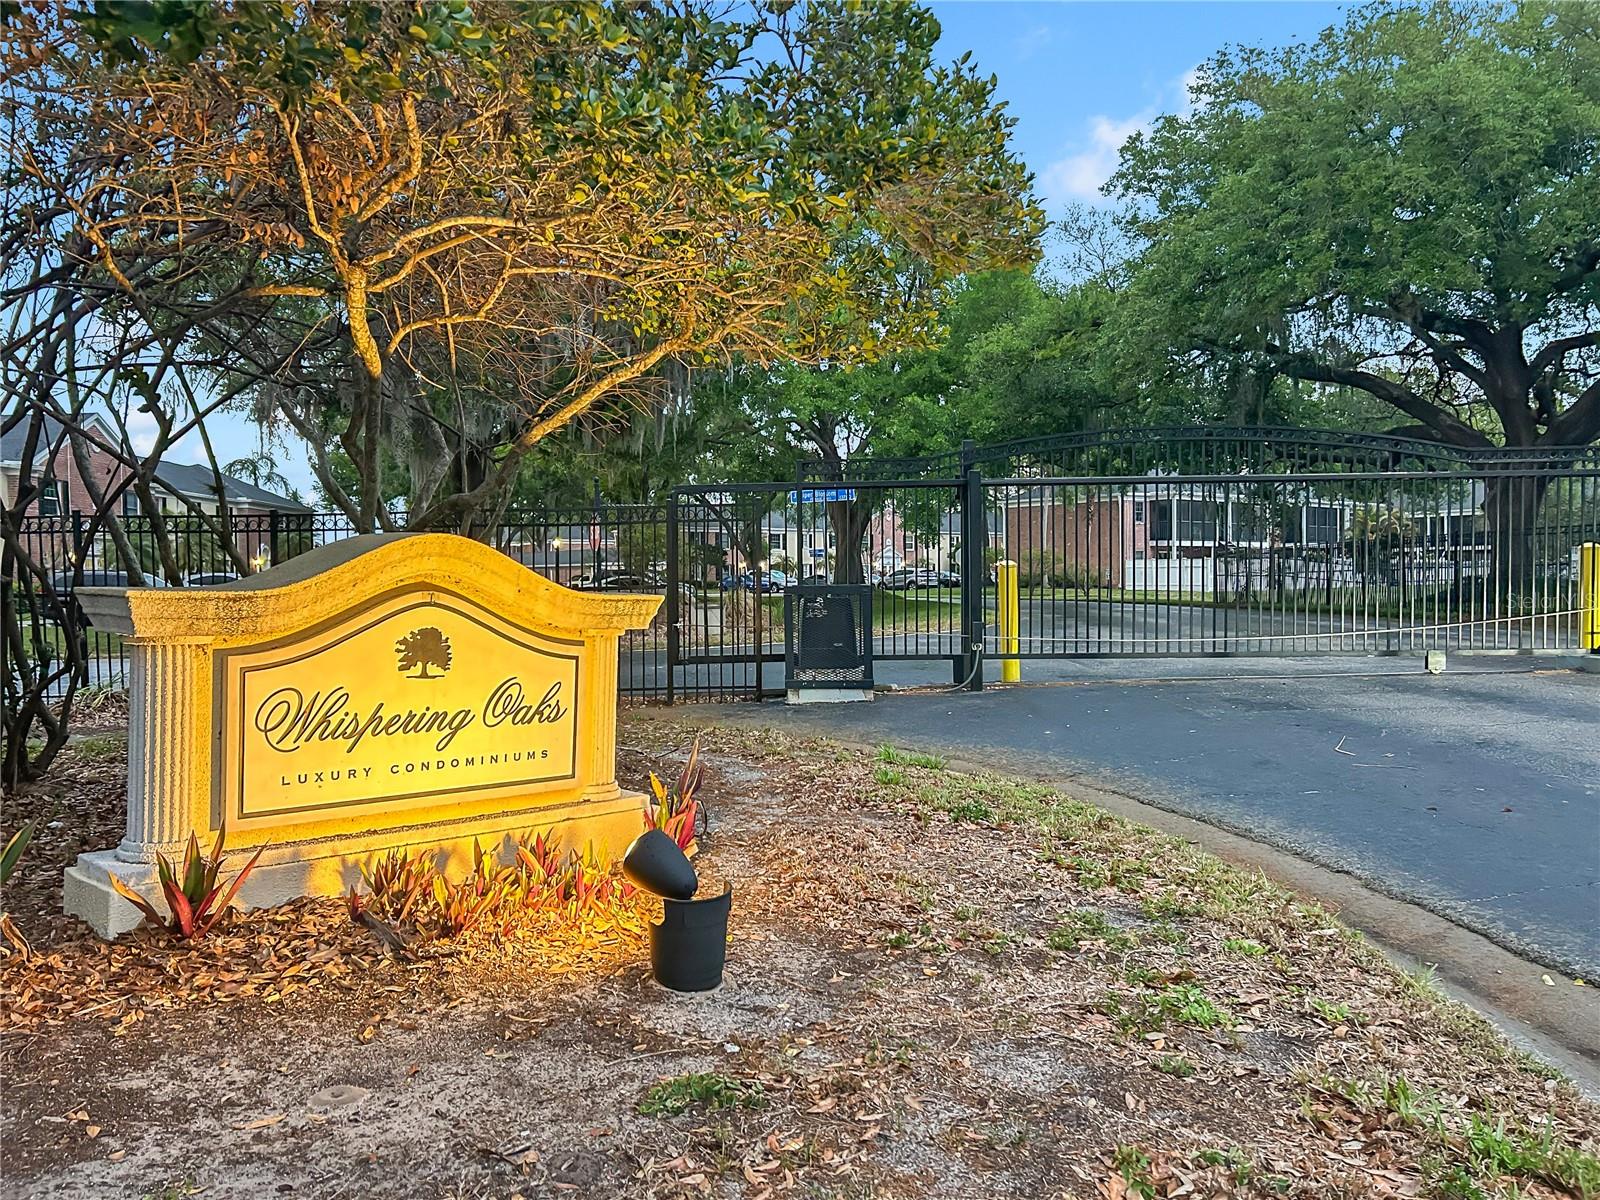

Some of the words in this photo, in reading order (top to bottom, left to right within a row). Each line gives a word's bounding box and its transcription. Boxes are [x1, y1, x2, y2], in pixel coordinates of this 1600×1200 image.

[255, 686, 475, 753] Whispering
[483, 677, 567, 729] Oaks
[281, 766, 372, 786] LUXURY
[390, 749, 549, 775] CONDOMINIUMS
